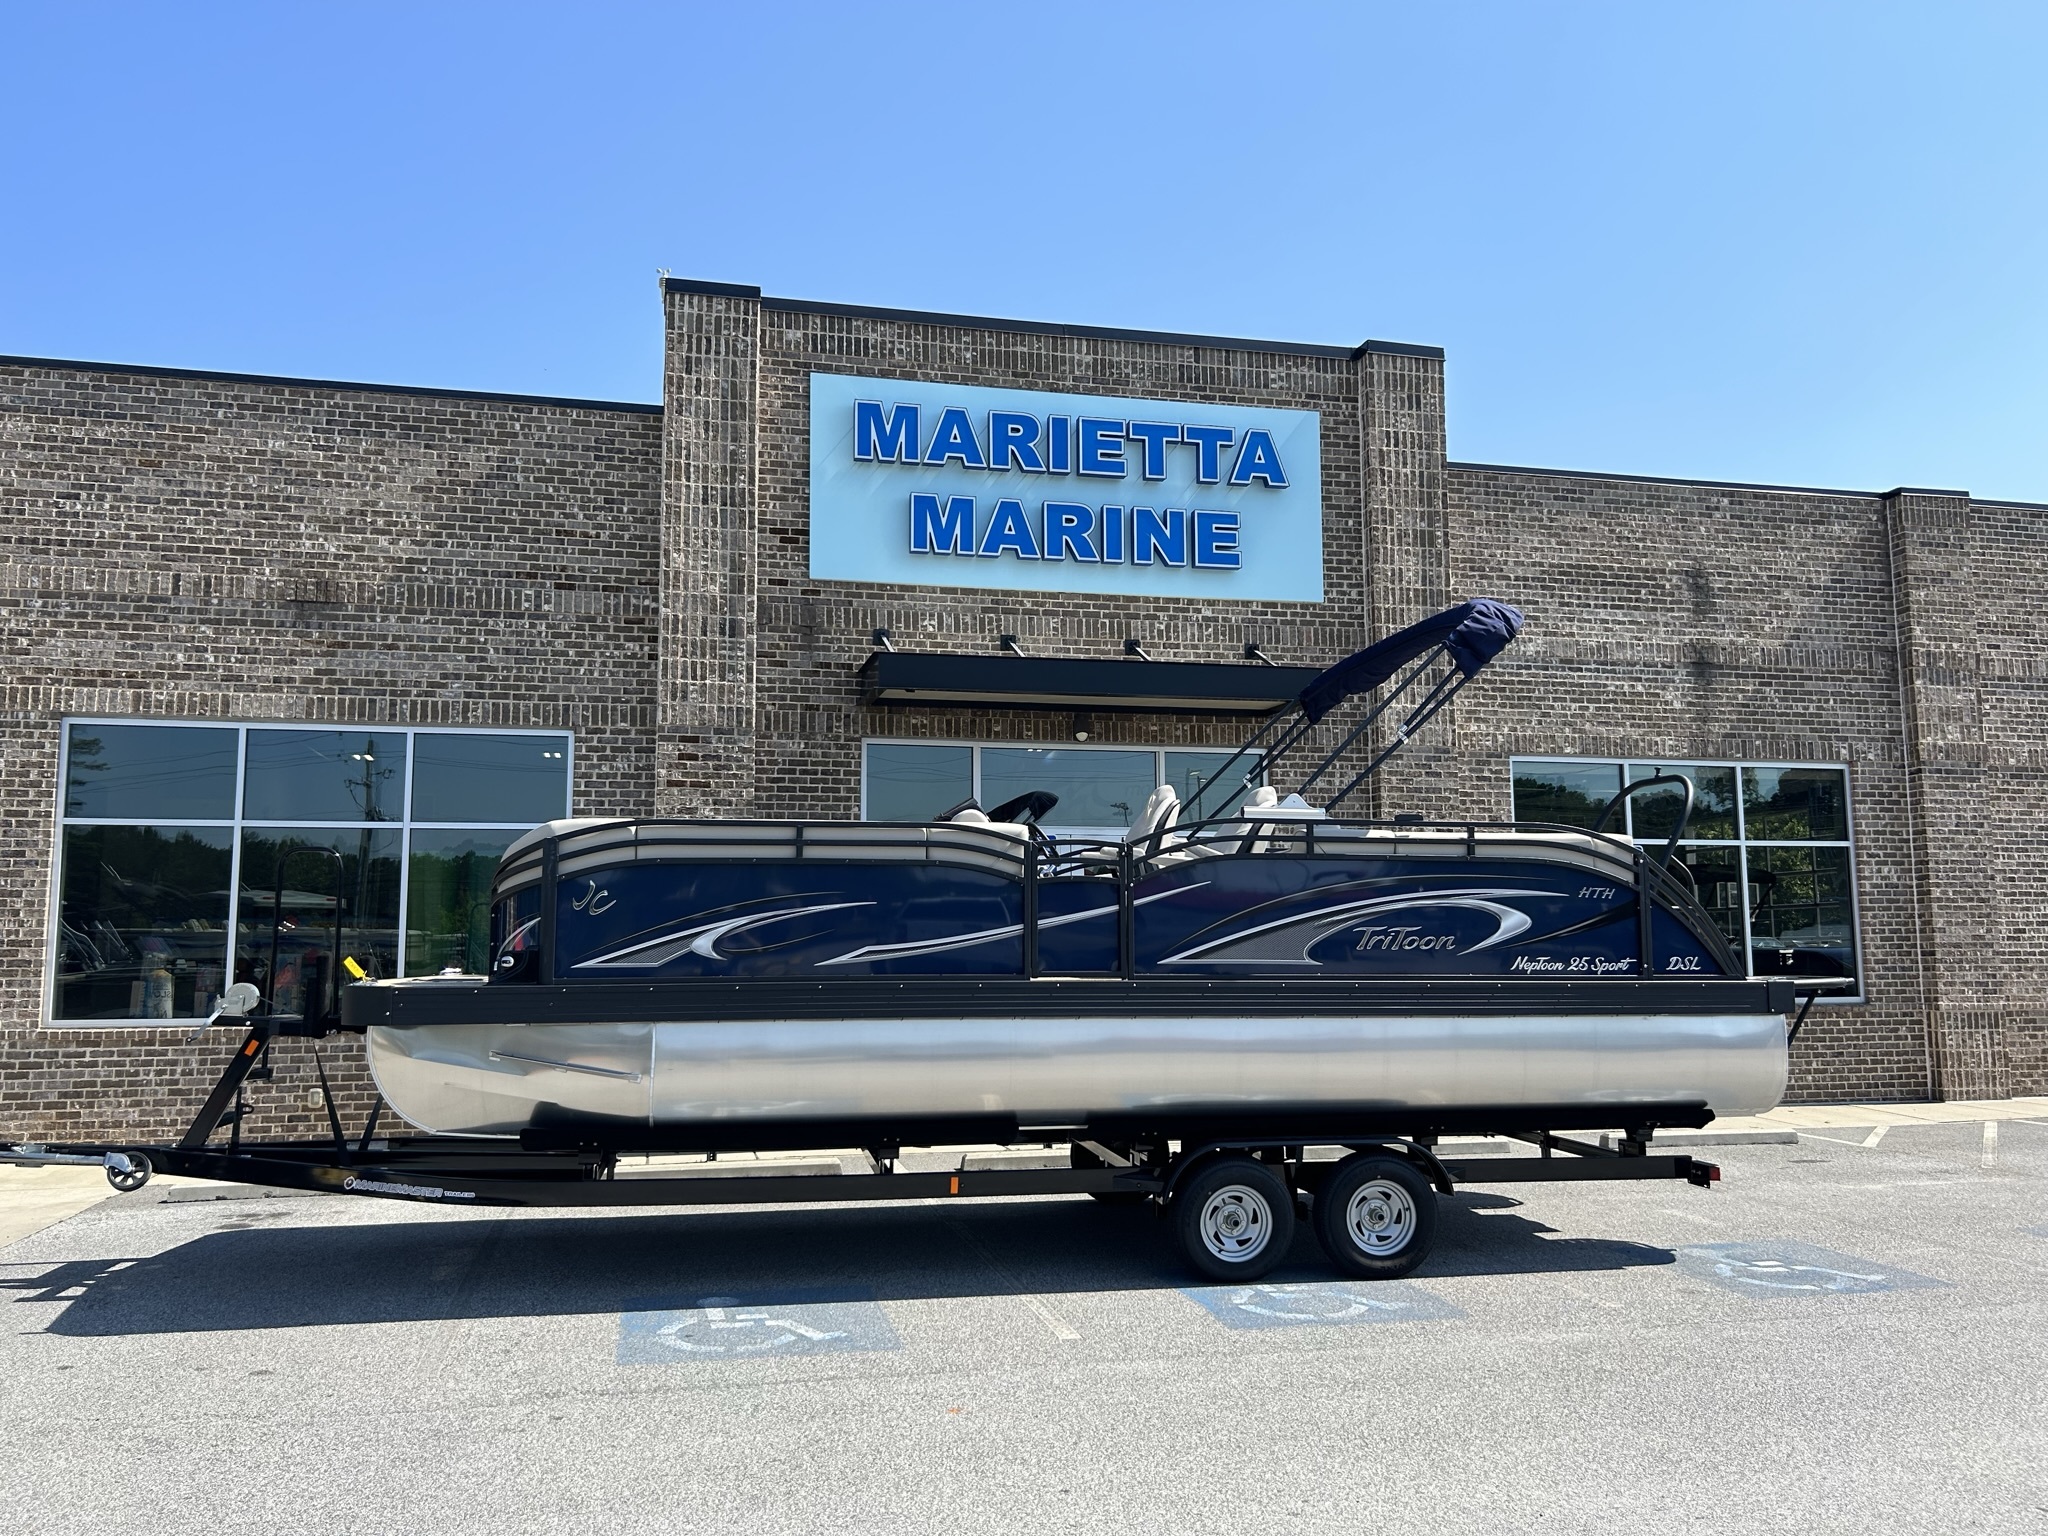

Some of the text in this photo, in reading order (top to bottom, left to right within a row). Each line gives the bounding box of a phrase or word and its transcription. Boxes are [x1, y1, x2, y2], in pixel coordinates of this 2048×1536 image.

[853, 399, 1291, 489] MARIETTA
[909, 492, 1242, 571] MARINE
[1577, 886, 1616, 900] HTH
[1352, 926, 1457, 951] TriToon
[1510, 955, 1638, 975] NepToon 25 Sport
[1665, 956, 1702, 971] DSL
